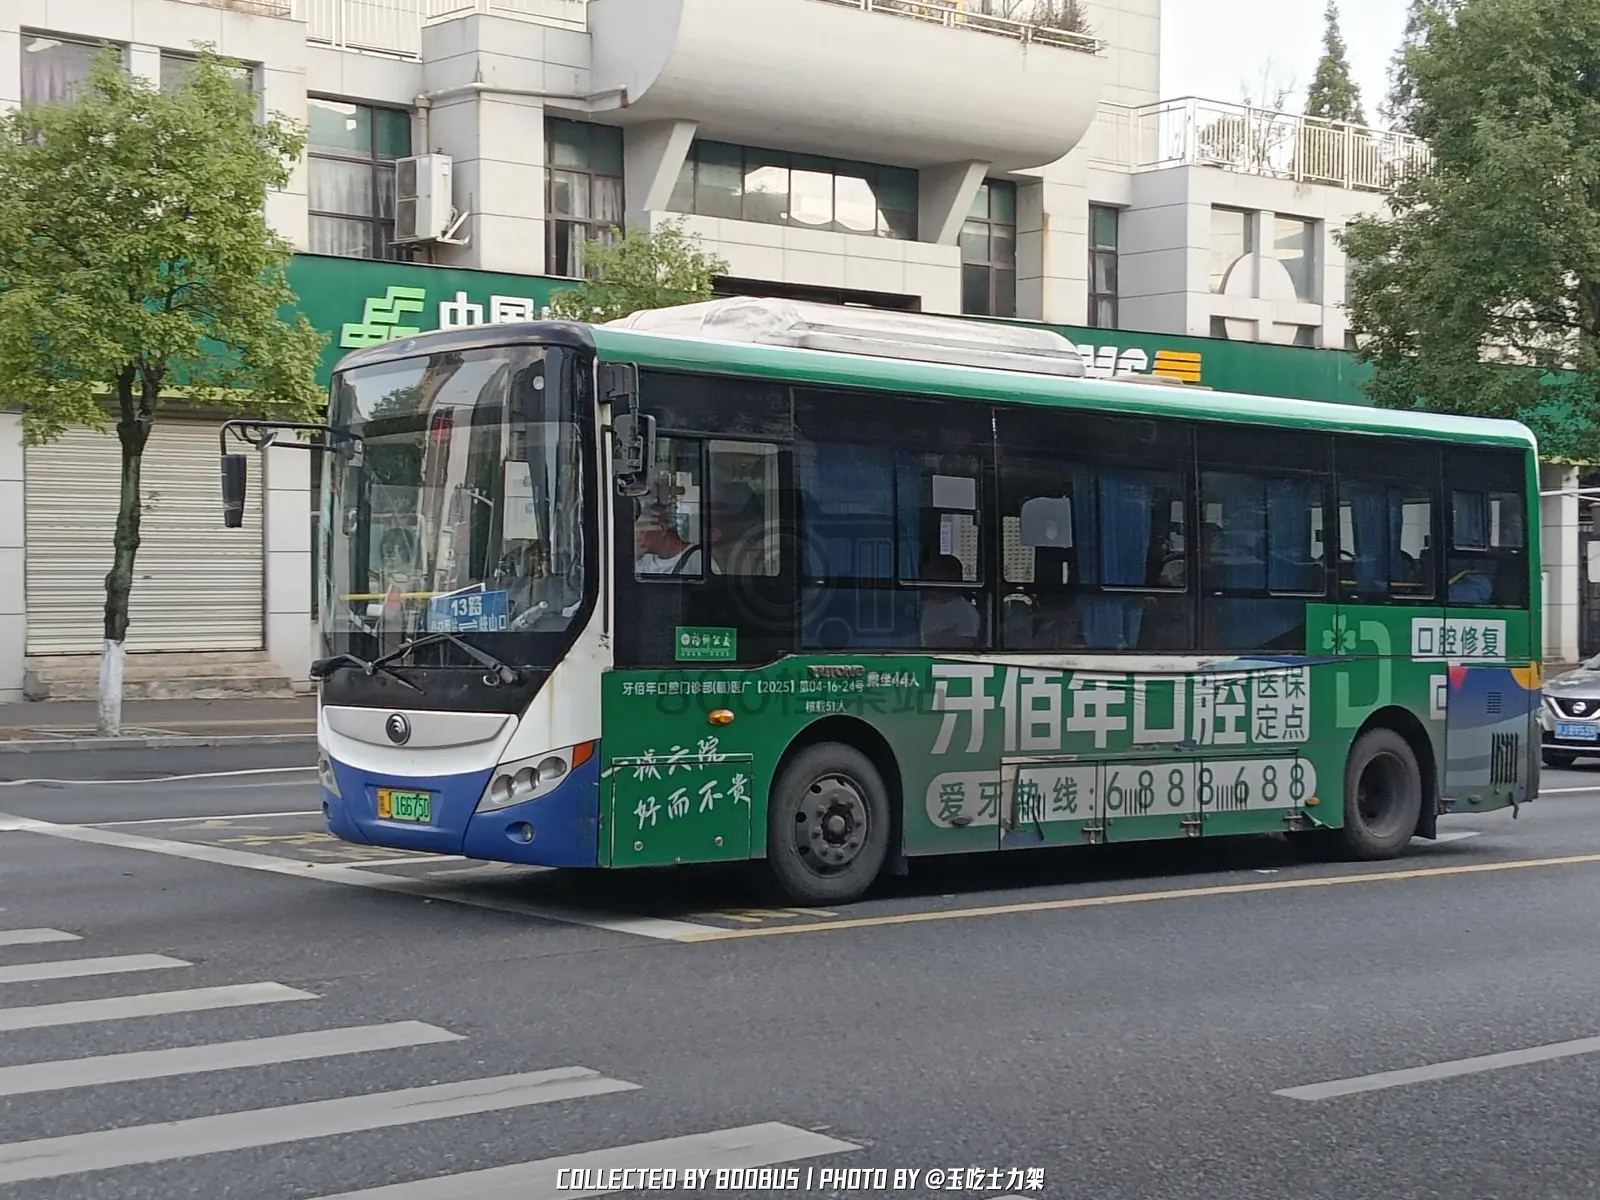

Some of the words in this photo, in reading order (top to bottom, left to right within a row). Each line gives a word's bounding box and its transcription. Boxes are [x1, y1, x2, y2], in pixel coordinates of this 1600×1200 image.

[439, 291, 549, 329] 中国
[1418, 626, 1499, 655] 口腔修复
[1256, 667, 1306, 699] 医保
[931, 664, 1247, 755] 牙佰年口腔
[1255, 703, 1305, 740] 定点
[633, 773, 752, 831] 好而不贵
